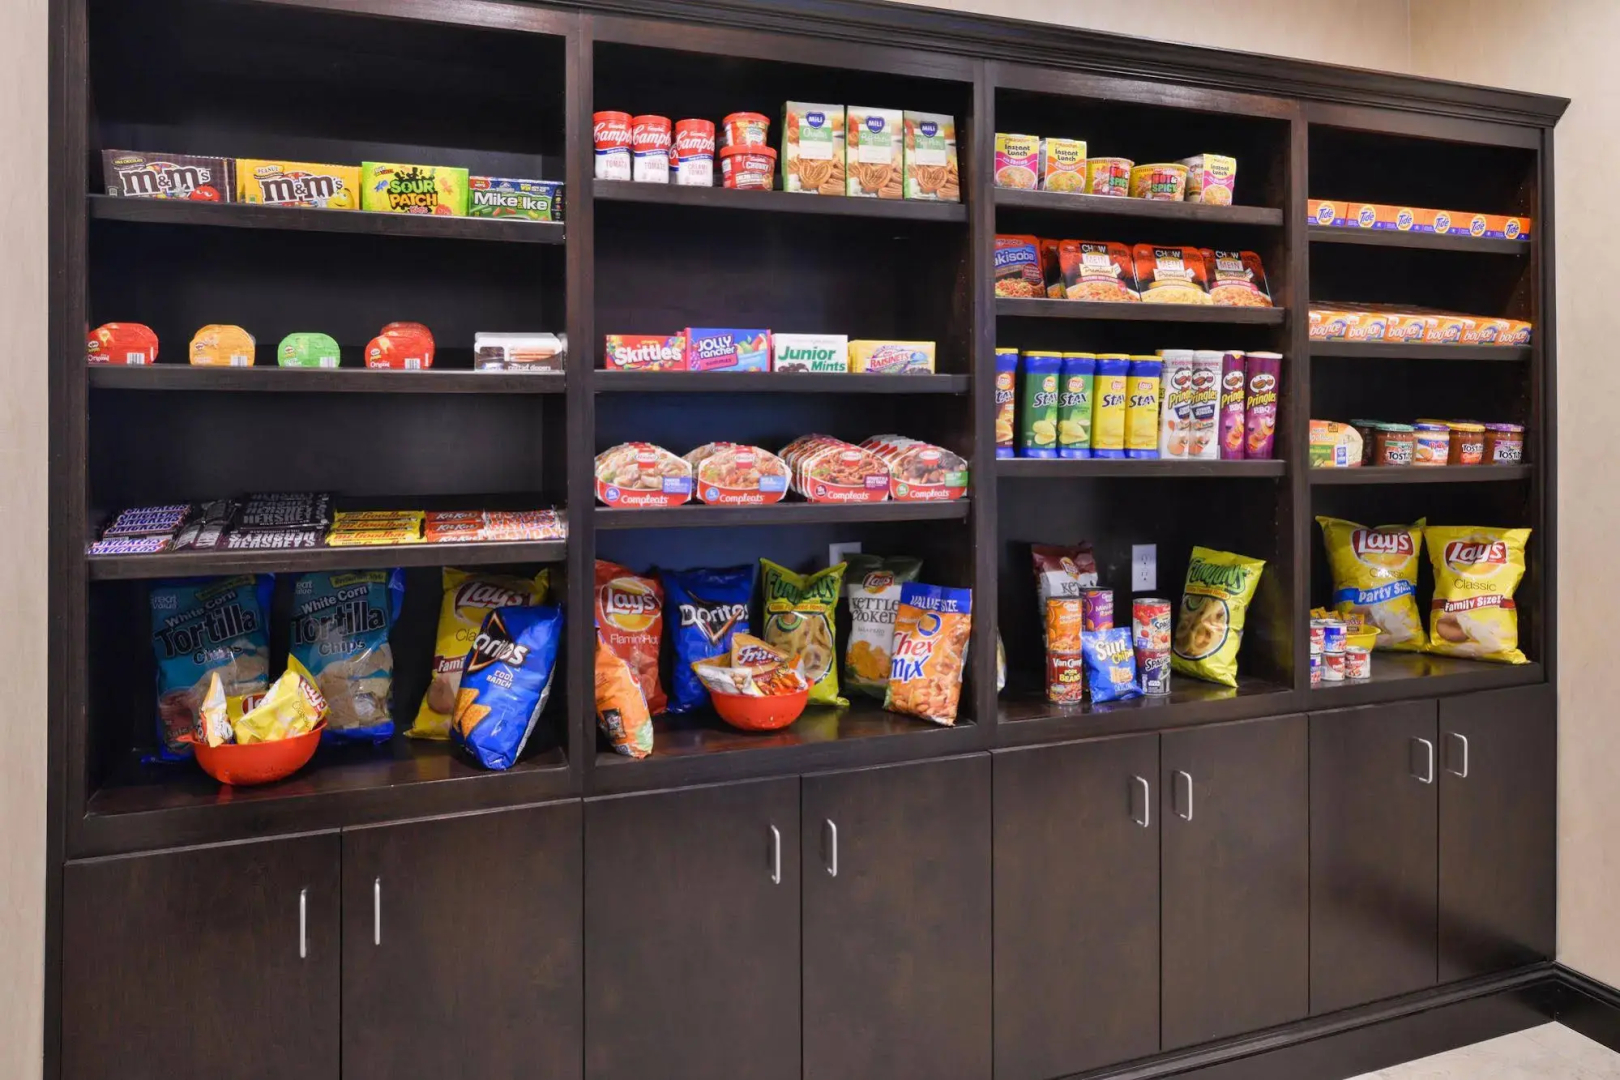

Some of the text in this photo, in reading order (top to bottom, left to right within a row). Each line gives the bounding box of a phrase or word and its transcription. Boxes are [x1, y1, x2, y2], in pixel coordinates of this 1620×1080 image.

[1055, 148, 1079, 156] Instant
[390, 179, 434, 194] SOUR
[388, 193, 438, 209] PATCH
[474, 191, 517, 207] Mike
[523, 196, 548, 211] Ike
[1318, 207, 1334, 220] Tide
[1360, 210, 1375, 222] Tide
[1398, 214, 1413, 226] Tide
[1434, 217, 1449, 229] Tide
[1471, 220, 1485, 232] Tide
[1506, 223, 1520, 235] Tide
[698, 336, 732, 352] JOLLY
[614, 343, 682, 366] Skittles
[700, 346, 735, 359] rancher
[778, 346, 836, 361] Junior
[811, 361, 846, 372] Mints
[870, 352, 909, 368] RAISINETS
[1247, 391, 1277, 410] Pringles
[1229, 403, 1243, 413] BBQ
[1253, 405, 1270, 414] BBQ
[621, 494, 668, 507] Compleats
[719, 493, 765, 505] Compleats
[827, 489, 869, 503] Compleats
[910, 488, 950, 501] Compleats
[454, 523, 474, 531] Kat
[1358, 530, 1410, 554] Lay's
[1449, 541, 1504, 565] Lay's
[1454, 578, 1497, 592] Classic
[301, 586, 368, 614] White Corn
[607, 587, 656, 614] Lay's
[1359, 586, 1392, 603] Party
[165, 589, 236, 628] White Corn
[909, 595, 958, 612] VALUE SIZE
[1444, 599, 1475, 612] Family
[291, 600, 386, 645] Tortilla
[153, 602, 259, 659] Tortilla
[318, 639, 367, 657] Chips
[891, 630, 943, 657] Chex
[1095, 640, 1126, 662] Sun
[1053, 658, 1067, 667] Van
[486, 675, 512, 688] RANCH
[494, 670, 514, 682] COOL
